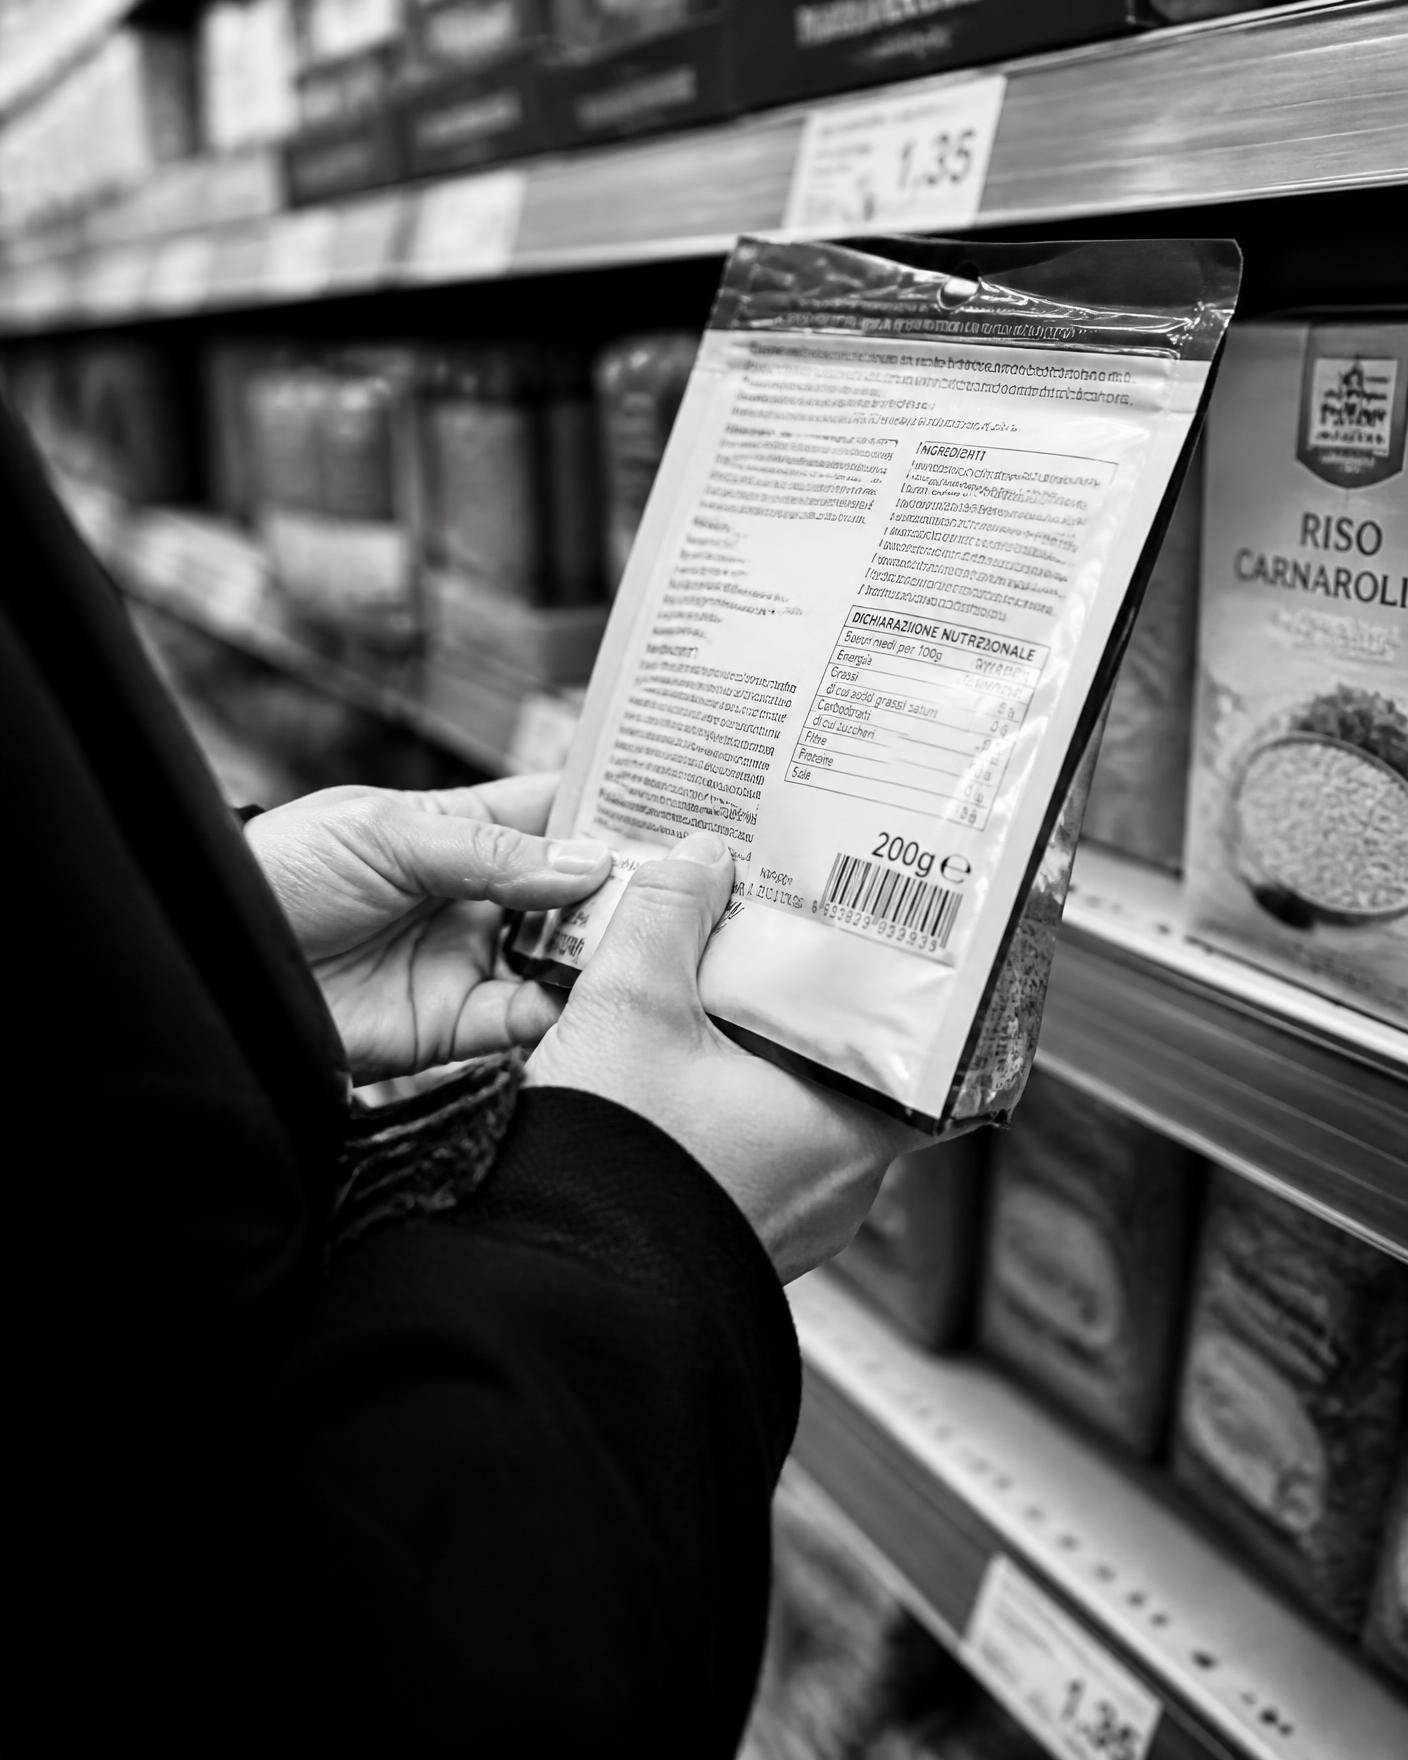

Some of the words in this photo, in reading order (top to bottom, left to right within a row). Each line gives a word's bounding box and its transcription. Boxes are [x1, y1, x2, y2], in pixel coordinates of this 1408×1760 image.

[1300, 512, 1384, 557] RISO
[1234, 547, 1408, 609] CARNAROLI
[872, 832, 936, 878] 200g
